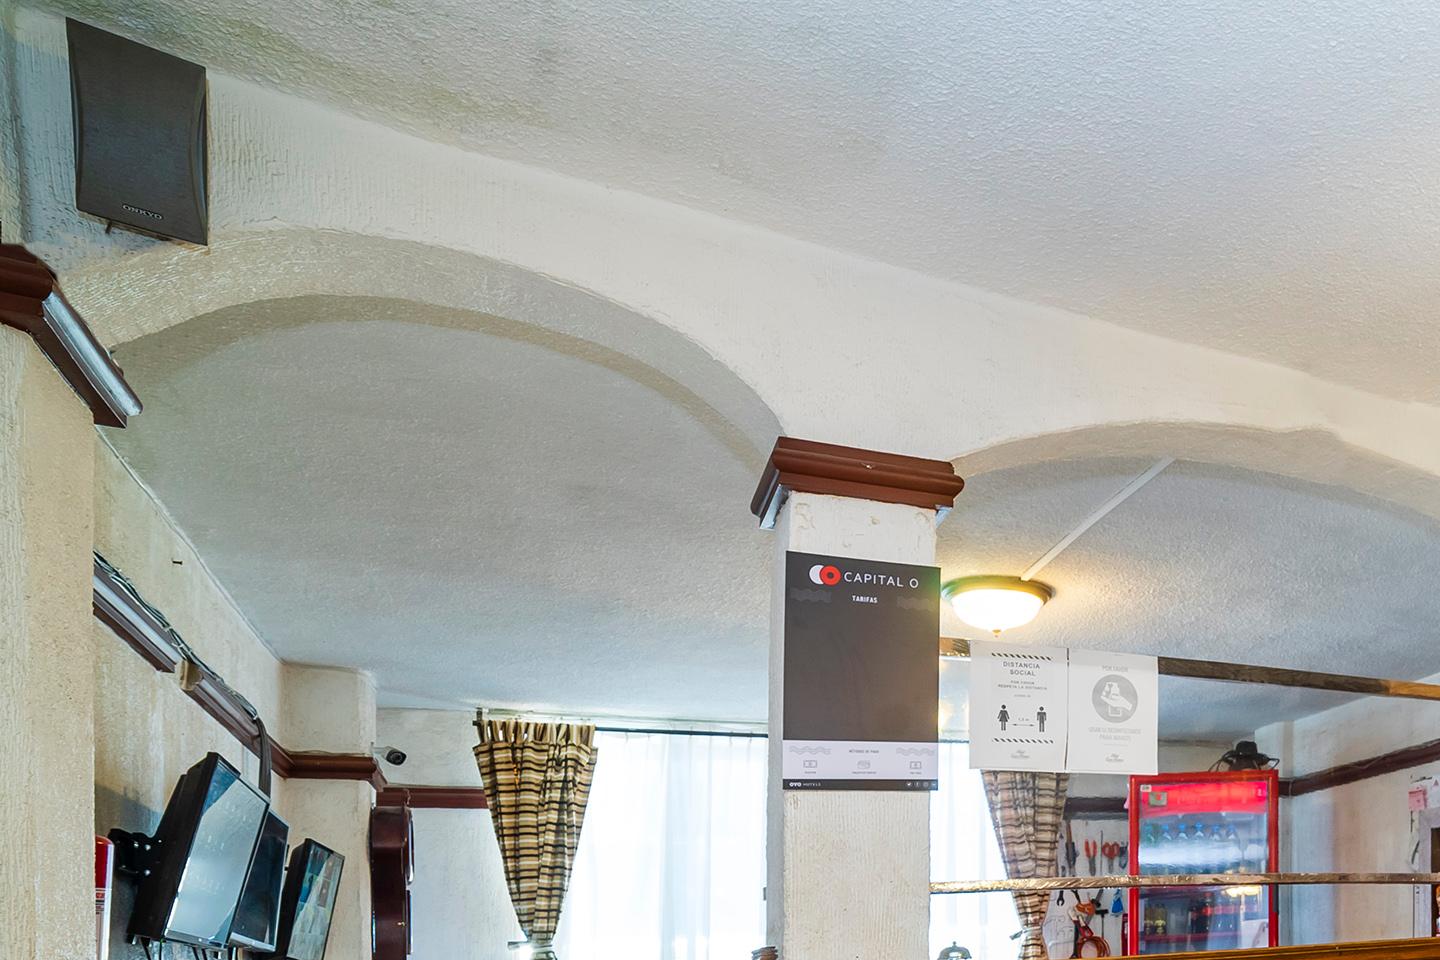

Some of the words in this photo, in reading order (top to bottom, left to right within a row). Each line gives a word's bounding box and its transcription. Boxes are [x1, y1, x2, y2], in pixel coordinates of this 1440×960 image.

[122, 204, 163, 220] ONKYO
[843, 571, 904, 588] CAPITAL
[909, 578, 919, 589] O
[851, 595, 878, 604] TARIFAS
[1002, 660, 1041, 670] DISTANCIA
[1009, 669, 1037, 677] SOCIAL
